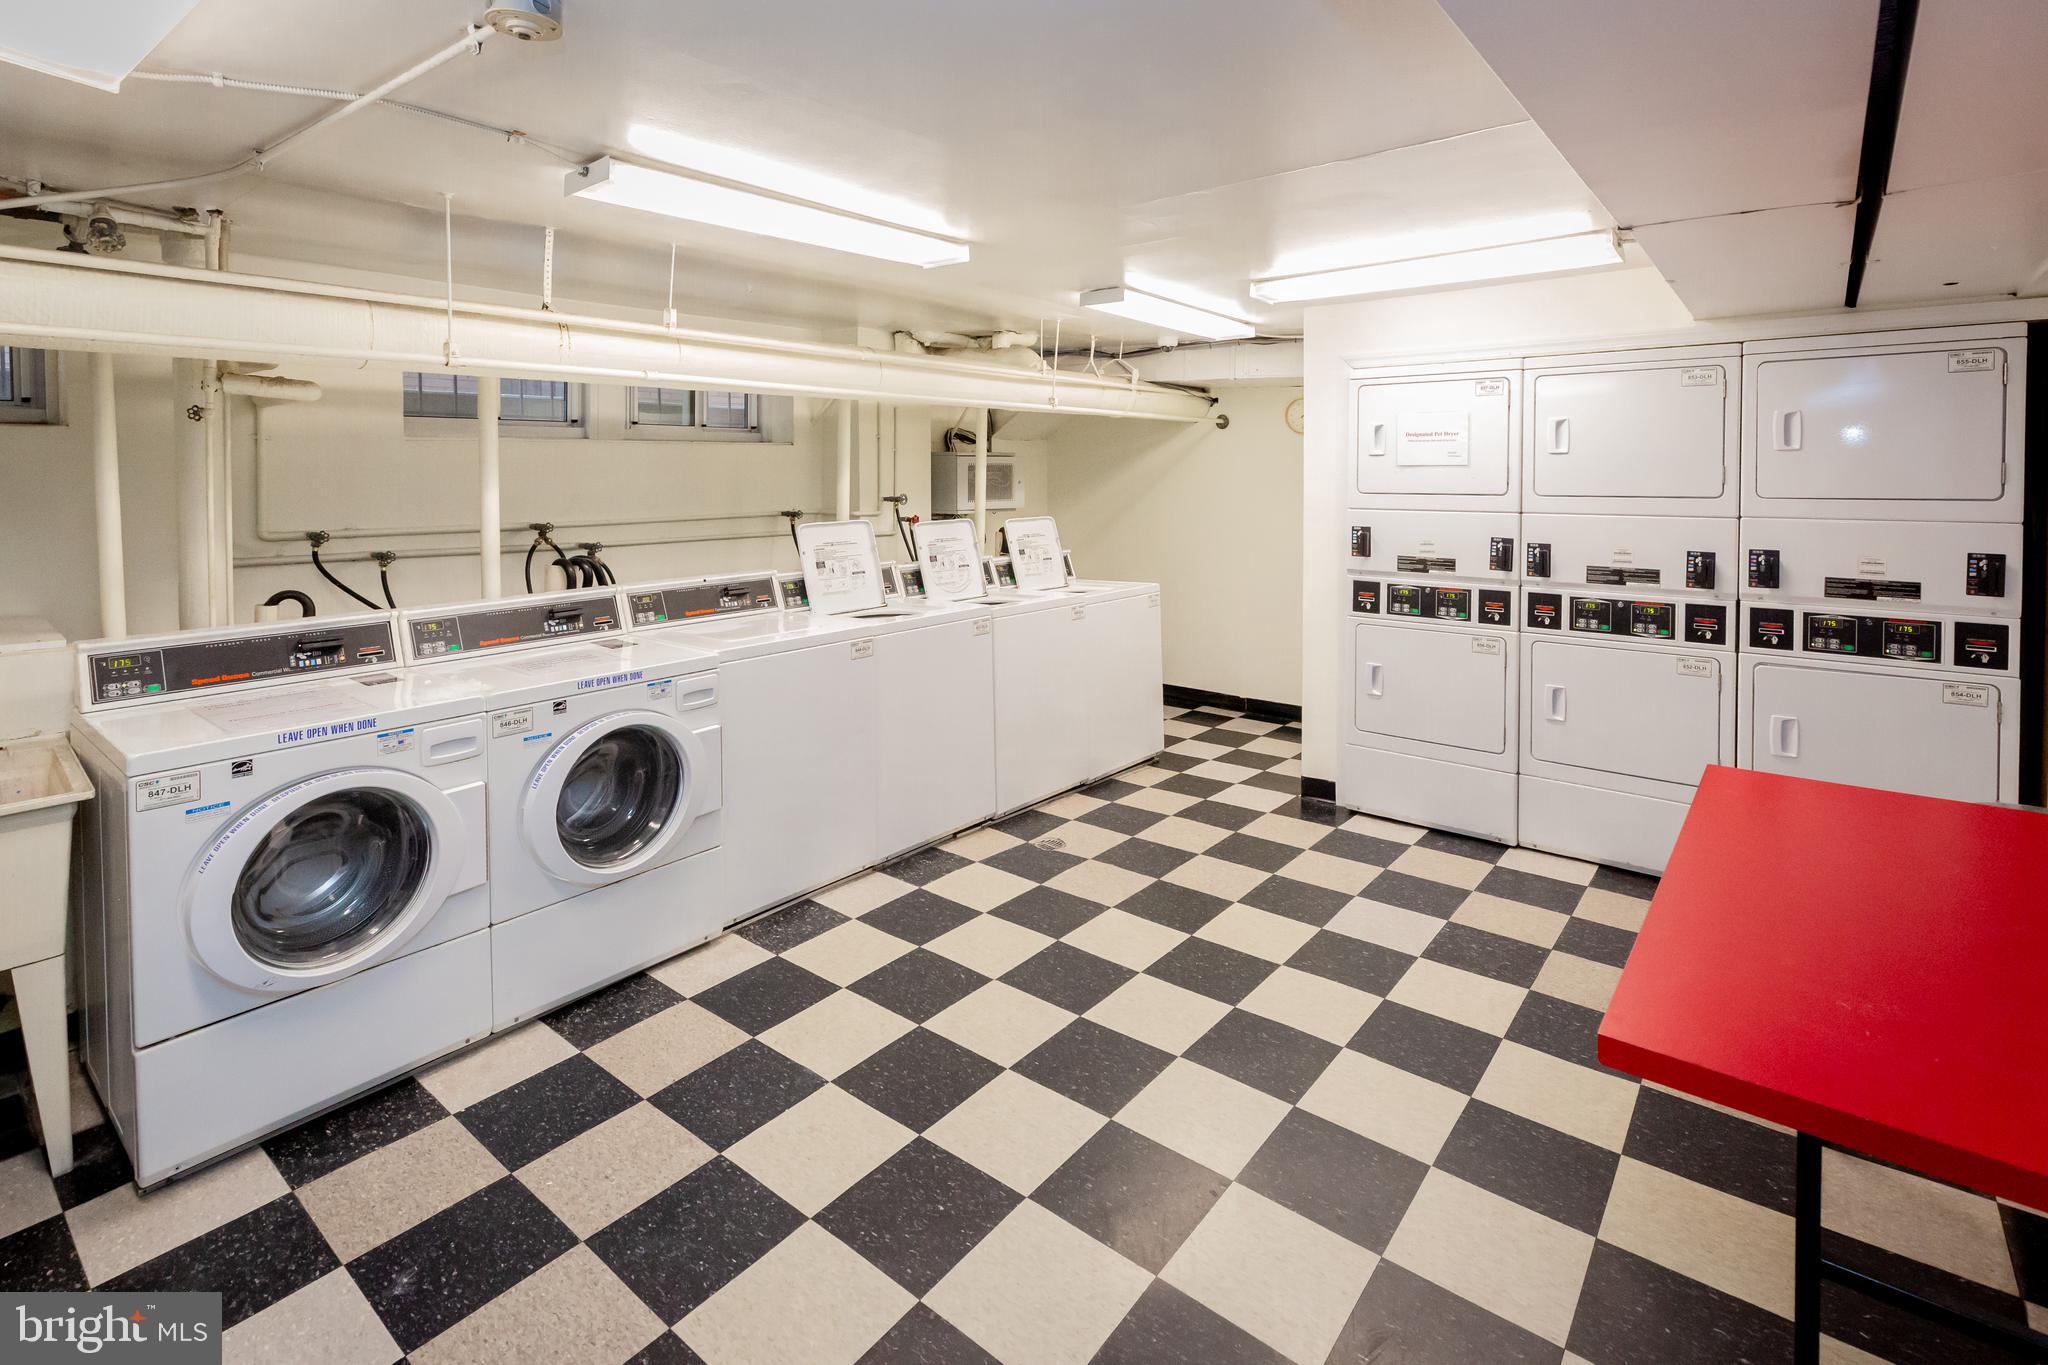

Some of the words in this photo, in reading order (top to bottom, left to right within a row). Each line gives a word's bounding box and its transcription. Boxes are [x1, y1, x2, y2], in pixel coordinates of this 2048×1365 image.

[112, 658, 131, 668] 175
[191, 675, 221, 686] Speed
[221, 672, 250, 681] Queen
[251, 667, 283, 677] Commercial
[577, 679, 595, 690] LEAVE
[596, 677, 611, 688] OPEN
[612, 674, 628, 684] WHEN
[629, 671, 643, 681] DONE
[277, 730, 304, 745] LEAVE
[306, 726, 328, 740] OPEN
[330, 722, 354, 735] WHEN
[357, 717, 377, 731] DONE
[147, 783, 192, 798] 847-DLH
[198, 853, 215, 874] LEAVE
[213, 834, 230, 853] OPEN
[230, 817, 250, 834] WHEN
